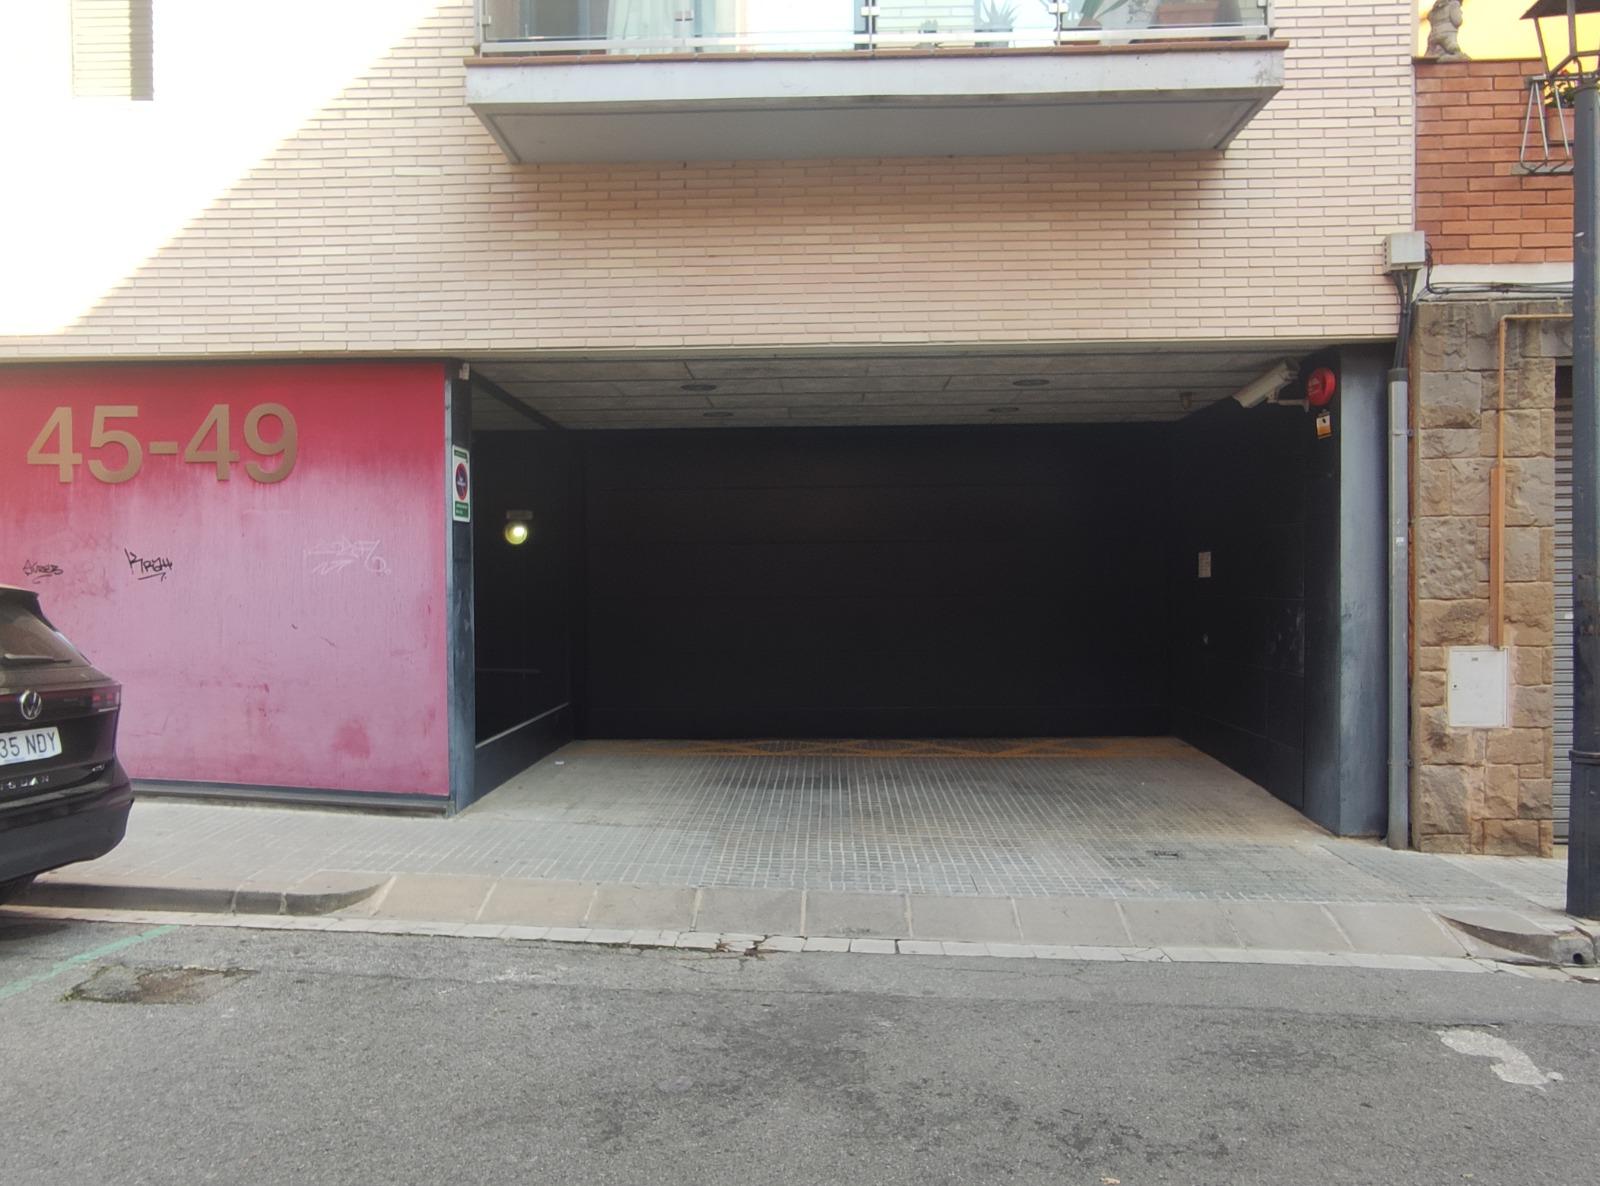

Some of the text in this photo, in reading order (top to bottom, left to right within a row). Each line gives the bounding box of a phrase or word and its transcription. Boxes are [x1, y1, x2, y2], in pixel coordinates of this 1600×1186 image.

[27, 402, 298, 484] 45-49
[0, 731, 56, 759] 35 NDY
